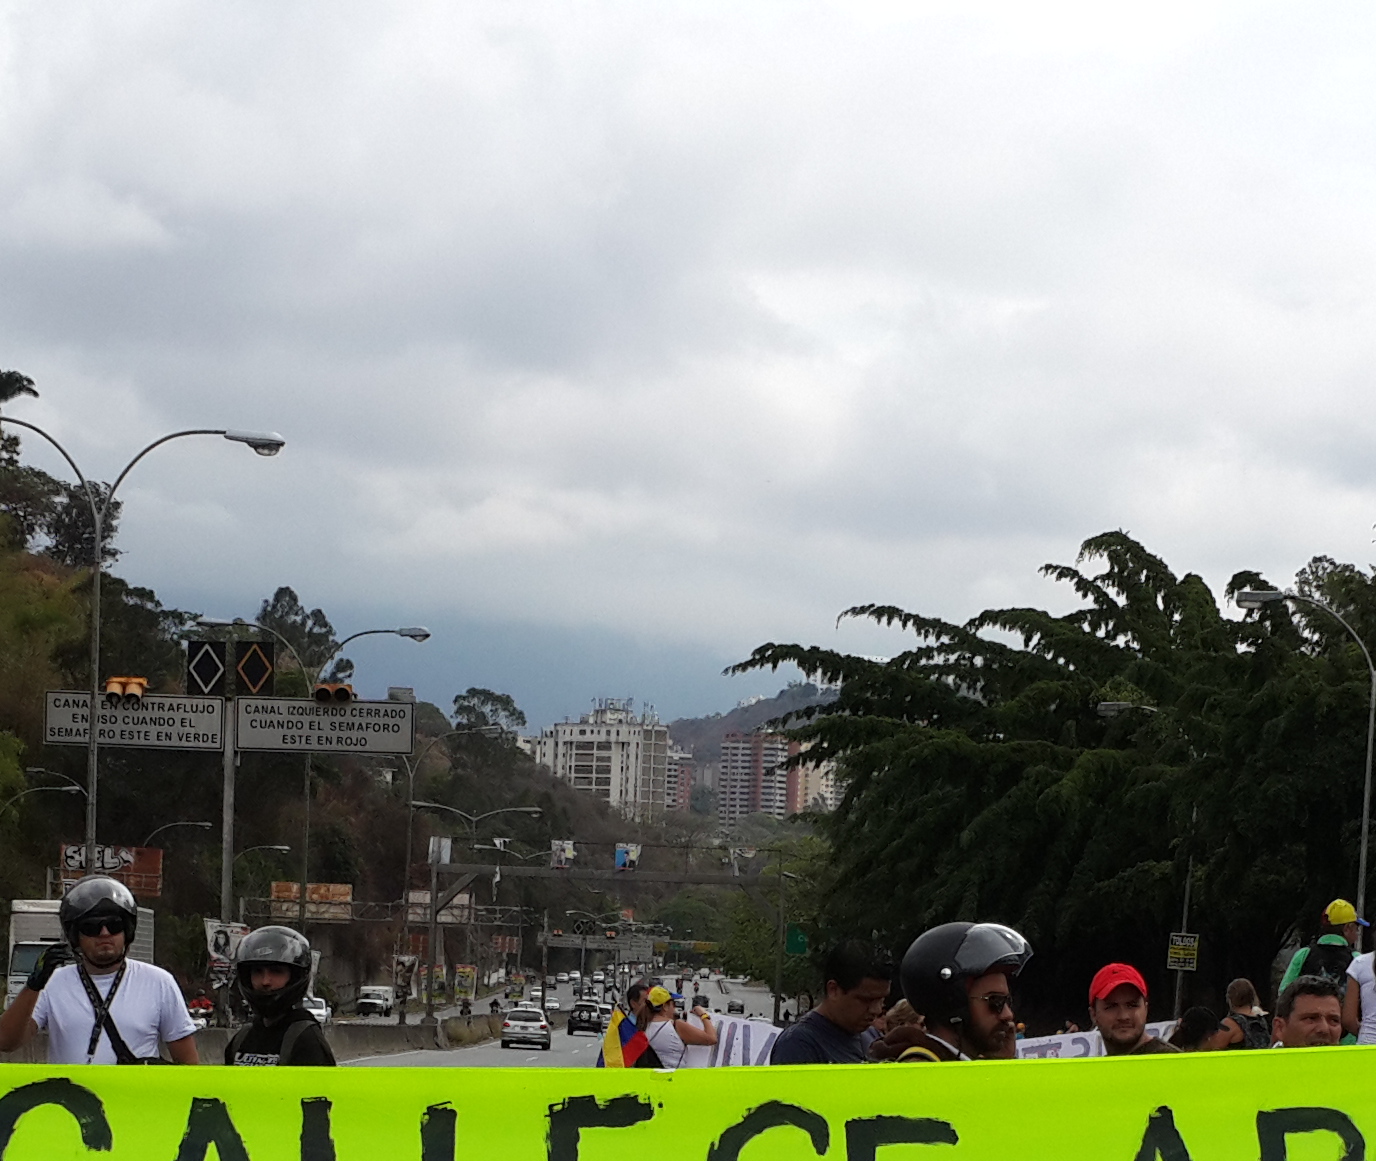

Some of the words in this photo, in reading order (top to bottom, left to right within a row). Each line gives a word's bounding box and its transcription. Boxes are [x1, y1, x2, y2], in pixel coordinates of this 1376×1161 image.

[53, 698, 91, 709] CANA
[100, 701, 118, 711] EN
[123, 702, 215, 714] CONTRAFLUJO
[245, 704, 283, 715] CANAL
[287, 706, 347, 718] IZQUIERDO
[350, 709, 406, 719] CERRADO
[71, 713, 89, 724] EN
[123, 716, 176, 727] CUANDO
[180, 718, 196, 728] EL
[250, 719, 304, 730] CUANDO
[309, 721, 324, 731] EL
[329, 722, 401, 733] SEMAFORO
[49, 727, 116, 739] SEMAFRO
[120, 730, 151, 741] ESTE
[157, 732, 173, 742] EN
[177, 732, 219, 744] VERDE
[282, 734, 312, 745] ESTE
[317, 735, 333, 746] EN
[336, 737, 368, 747] ROJO
